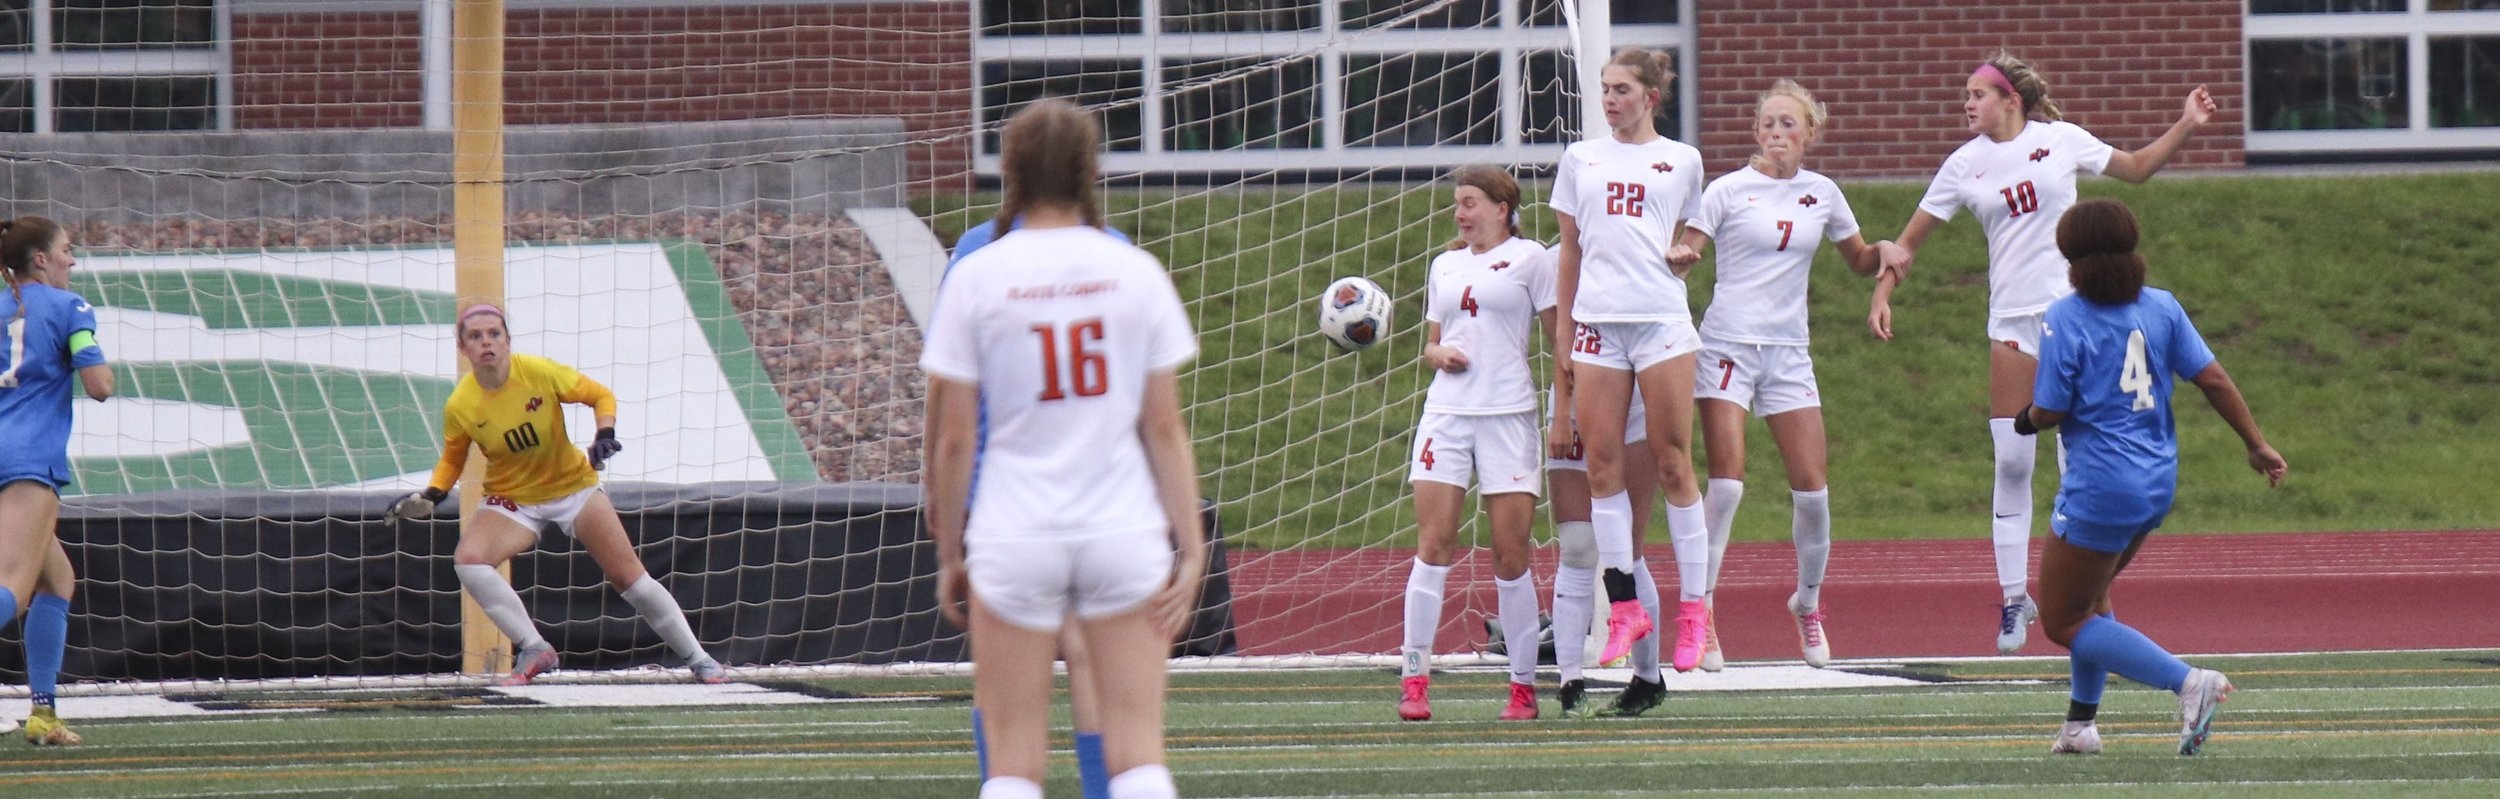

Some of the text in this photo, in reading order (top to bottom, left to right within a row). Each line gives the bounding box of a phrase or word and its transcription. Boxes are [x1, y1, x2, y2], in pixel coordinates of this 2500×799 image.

[1607, 181, 1645, 218] 22
[2000, 180, 2039, 218] 10
[1777, 220, 1793, 251] 7
[1460, 285, 1479, 317] 4
[1031, 316, 1109, 402] 16
[1719, 359, 1735, 390] 7
[2119, 329, 2155, 411] 4
[503, 422, 540, 453] 00
[1420, 438, 1435, 470] 4
